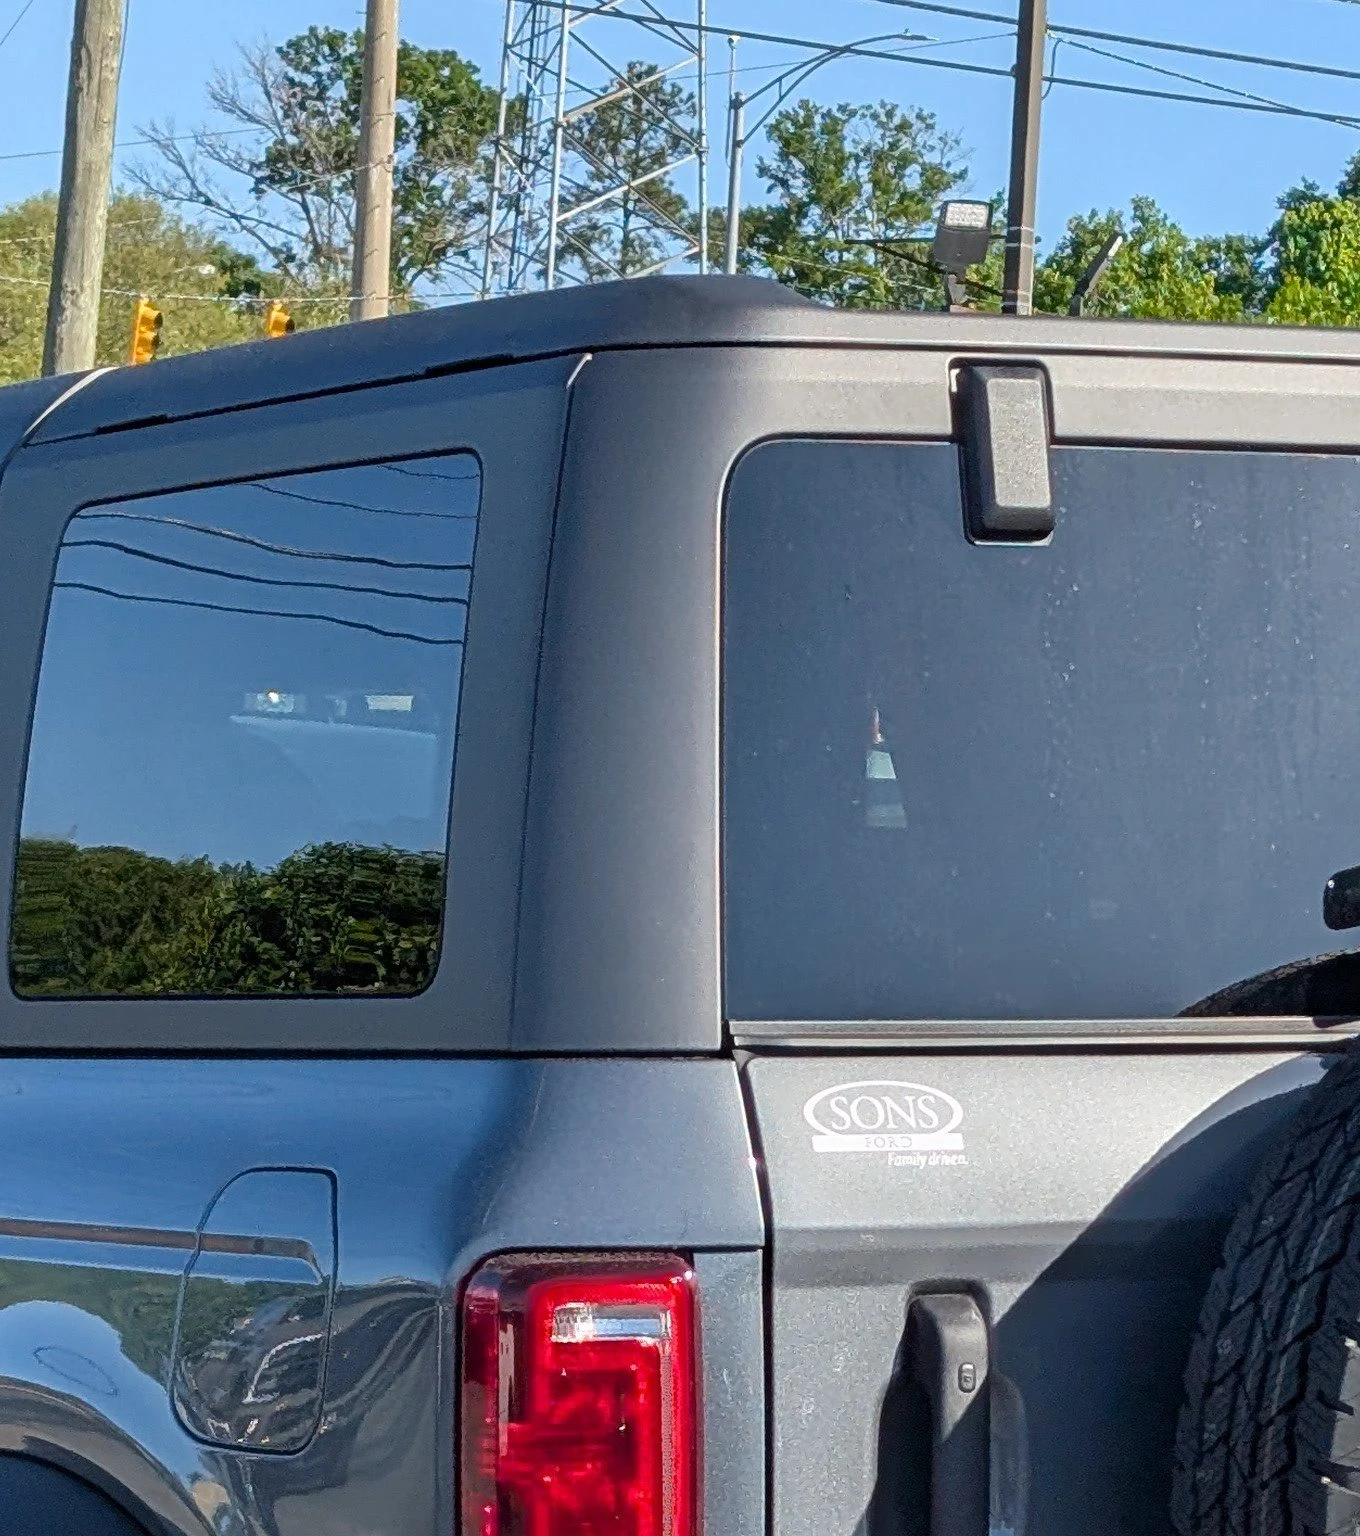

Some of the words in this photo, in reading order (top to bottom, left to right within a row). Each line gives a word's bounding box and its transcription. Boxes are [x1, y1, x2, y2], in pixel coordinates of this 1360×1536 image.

[829, 1094, 939, 1131] SONS
[864, 1136, 912, 1149] FORD
[888, 1151, 927, 1169] Family
